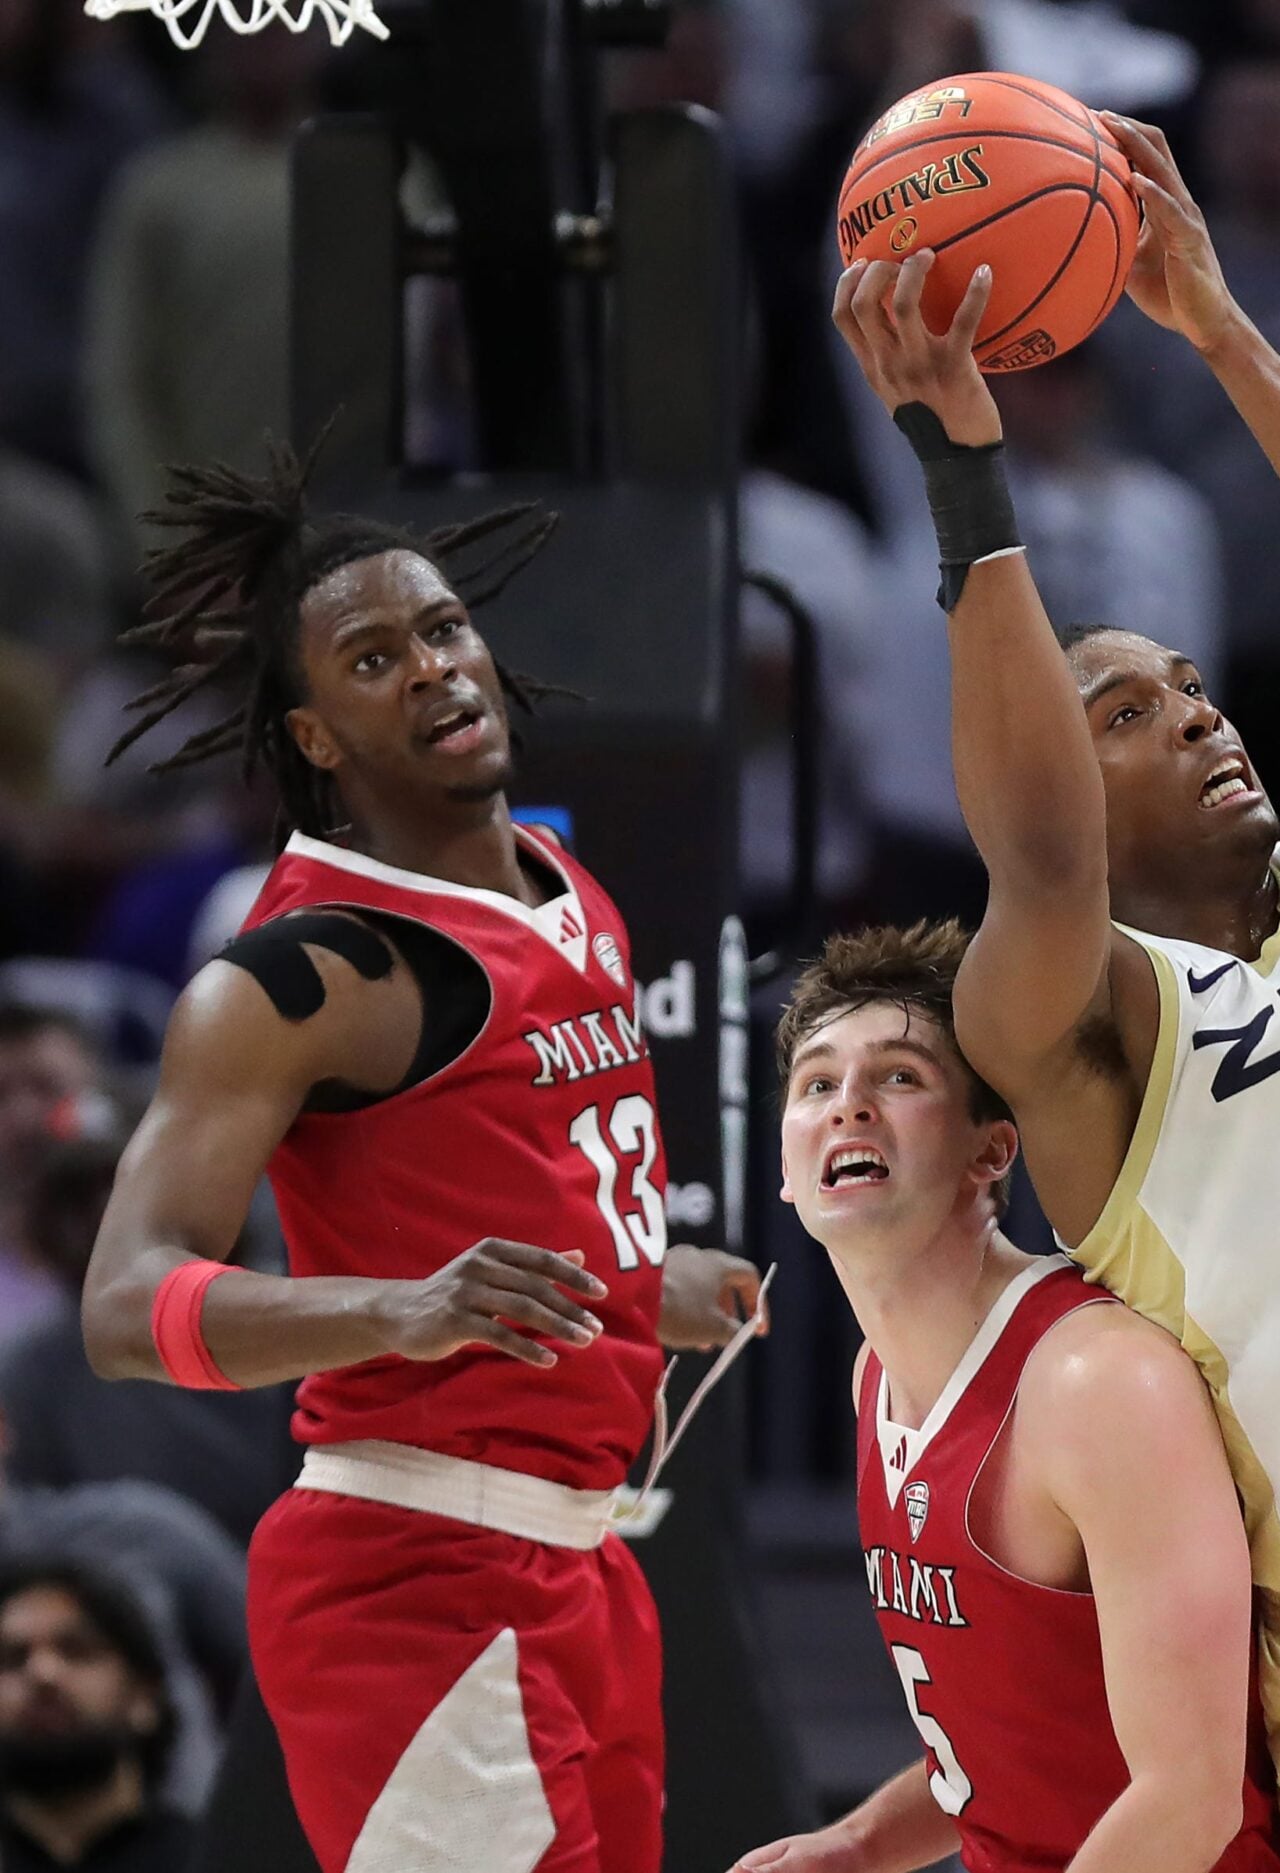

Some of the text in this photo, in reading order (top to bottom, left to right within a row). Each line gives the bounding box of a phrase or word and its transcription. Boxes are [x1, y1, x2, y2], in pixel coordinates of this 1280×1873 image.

[839, 145, 990, 258] SPALDING
[523, 1004, 650, 1087] MIAM
[569, 1094, 668, 1270] 13
[864, 1545, 970, 1627] MIAMI
[890, 1641, 973, 1817] 5
